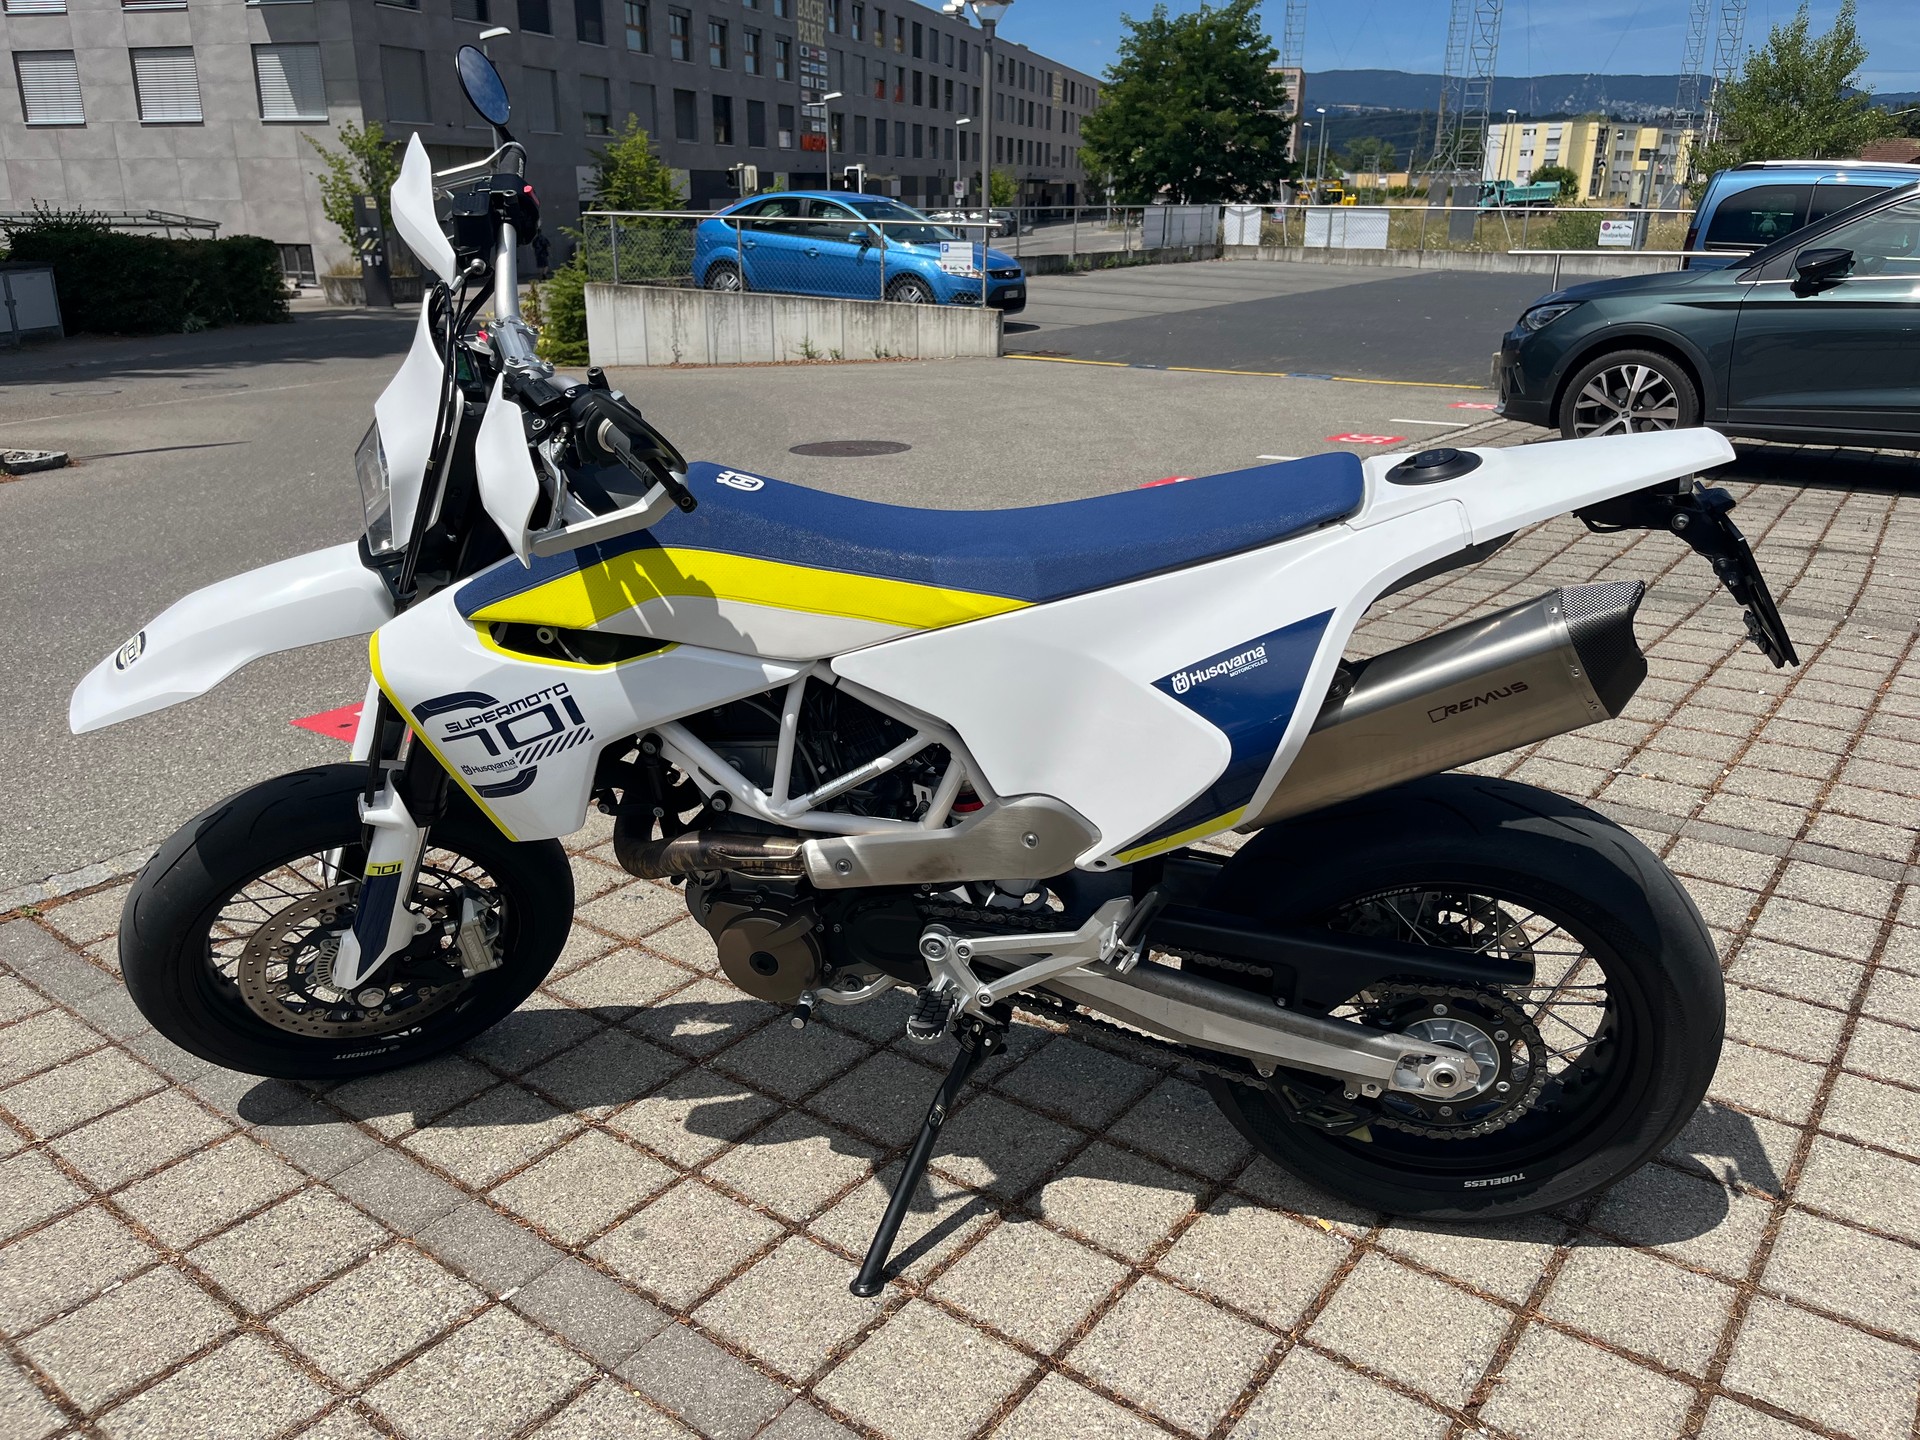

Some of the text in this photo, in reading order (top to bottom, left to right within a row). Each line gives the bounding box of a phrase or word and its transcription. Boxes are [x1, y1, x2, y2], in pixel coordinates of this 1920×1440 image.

[797, 19, 825, 47] PARK
[1190, 646, 1266, 686] Husqvarna
[1229, 659, 1268, 678] MOTORCYCLES
[444, 682, 569, 734] SUPERMOTO
[1444, 681, 1529, 717] REMUS
[441, 694, 586, 757] 701
[472, 757, 516, 774] Husqvarna
[371, 863, 402, 875] 701
[1463, 1172, 1526, 1188] TUBELESS
